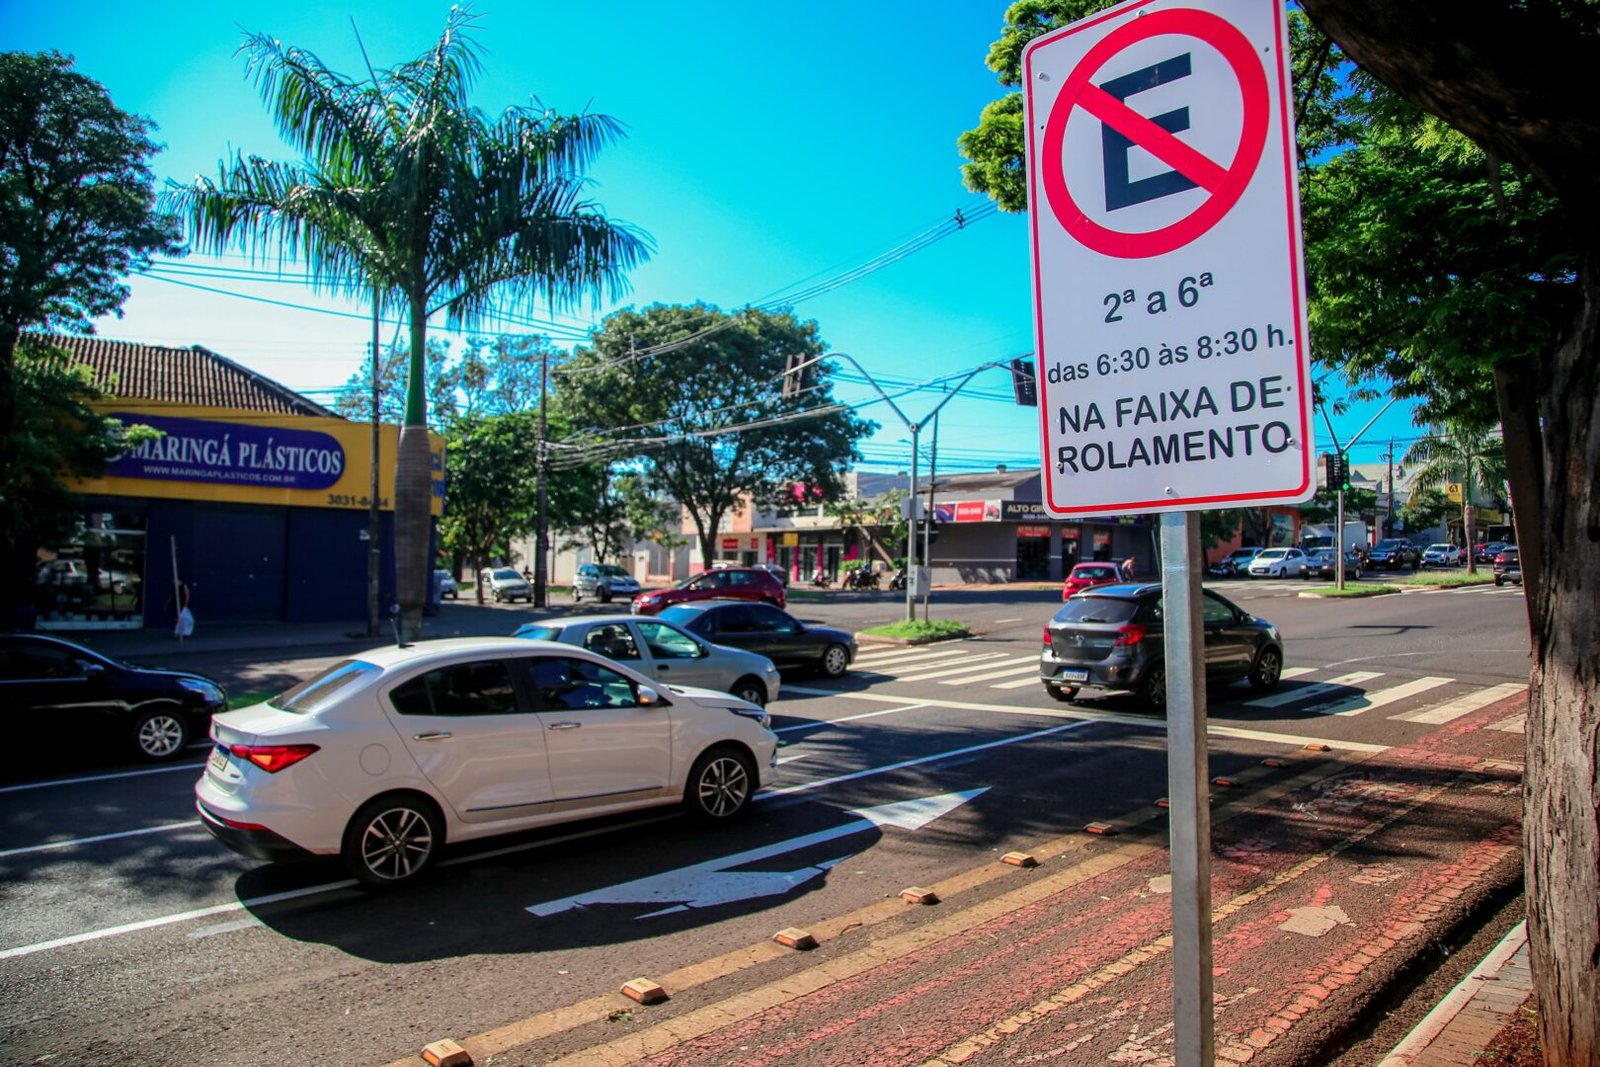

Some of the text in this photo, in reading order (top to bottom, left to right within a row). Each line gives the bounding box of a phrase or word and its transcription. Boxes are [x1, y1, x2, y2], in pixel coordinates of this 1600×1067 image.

[1099, 52, 1199, 212] E
[1103, 271, 1214, 324] 2ª a 6ª
[1047, 323, 1294, 384] das 6:30 às 8:30 h.
[1059, 375, 1285, 435] NA FAIXA DE
[131, 433, 342, 476] MARINGÁ PLÁSTICOS
[143, 465, 296, 484] WWW.MARINGAPLASTICOS.COM.BR
[1058, 420, 1293, 475] ROLAMENTO
[1007, 503, 1044, 513] ALTO GIR
